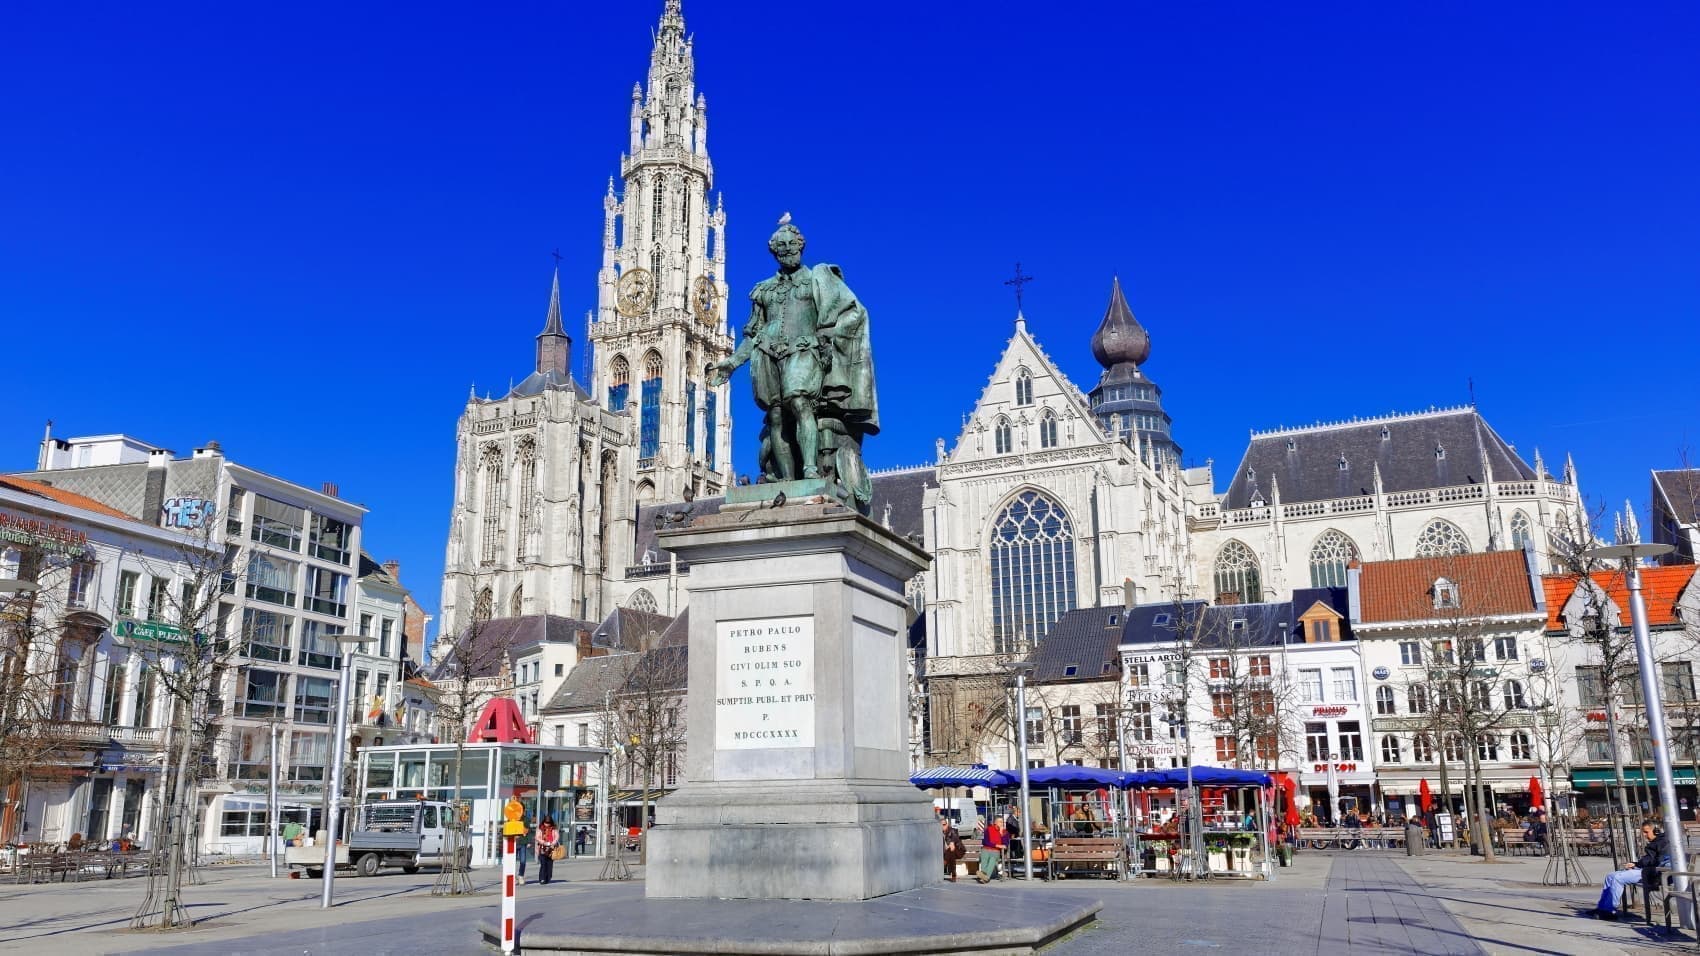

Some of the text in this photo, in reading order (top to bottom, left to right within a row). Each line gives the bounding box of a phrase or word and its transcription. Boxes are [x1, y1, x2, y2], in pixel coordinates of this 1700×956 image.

[730, 626, 801, 638] PETRO PAULO
[744, 643, 787, 653] RUBENS
[1124, 653, 1185, 664] STELLA ARTO
[730, 660, 802, 671] CIVI OLIM SUO
[1313, 706, 1348, 717] PRIMUS
[735, 729, 798, 740] MDCCCXXXX
